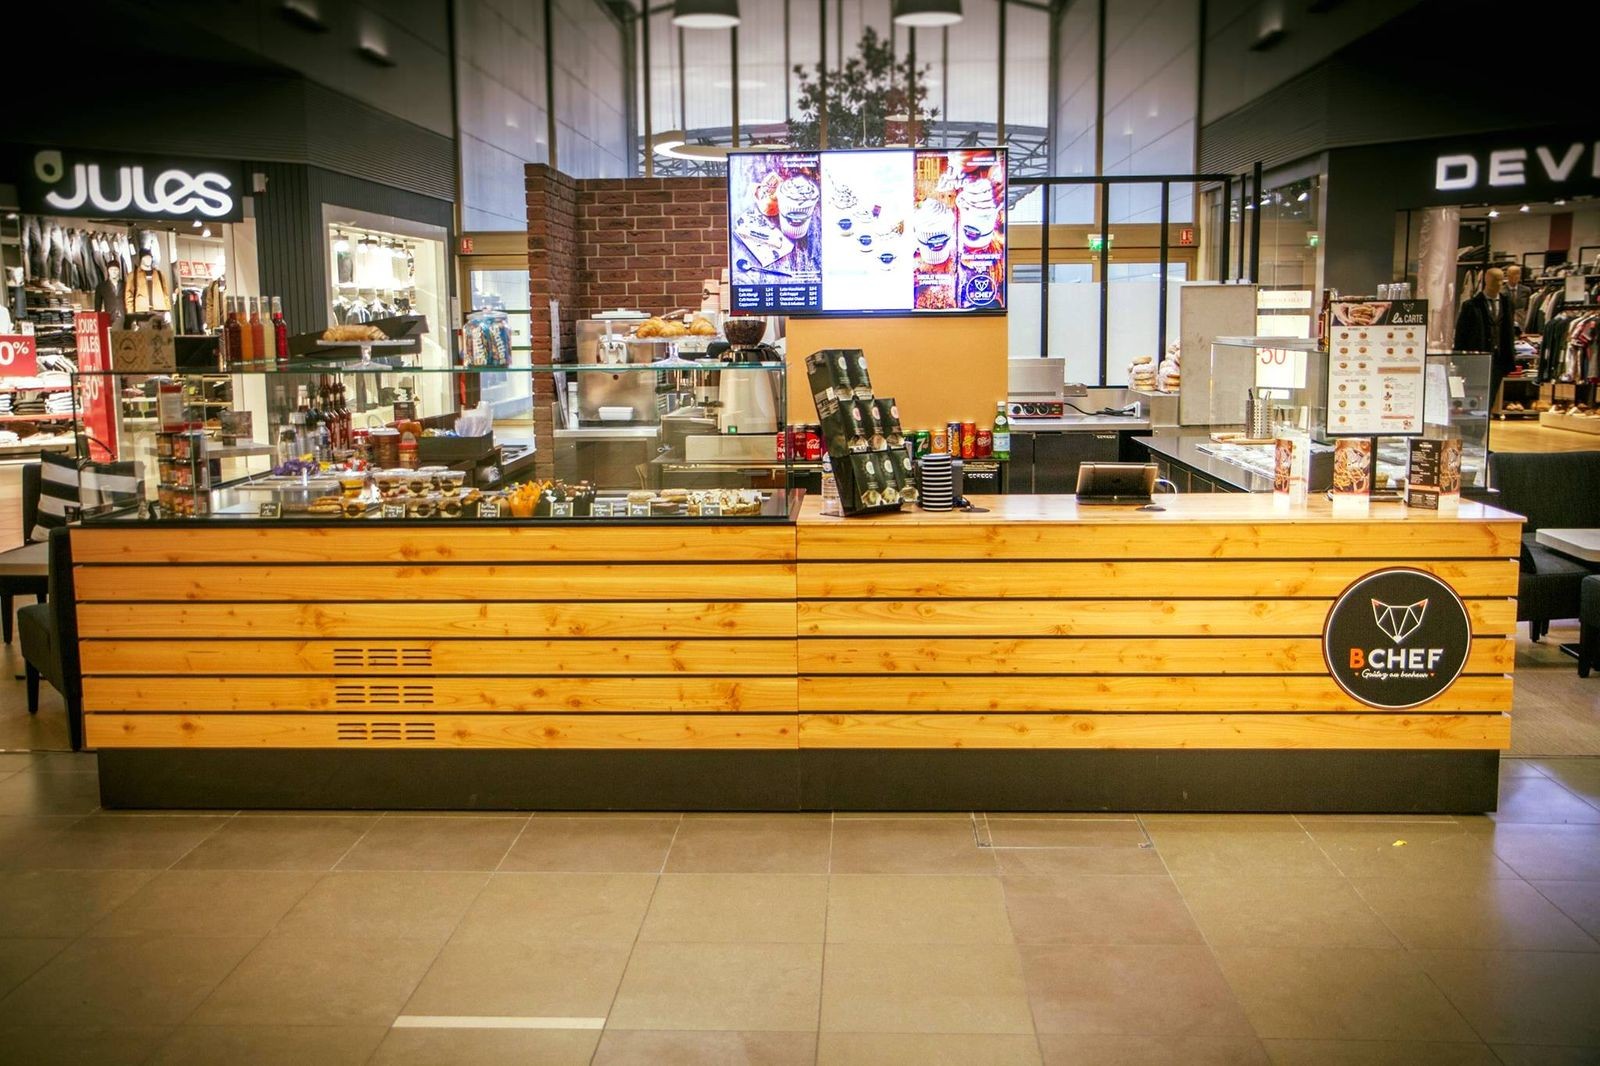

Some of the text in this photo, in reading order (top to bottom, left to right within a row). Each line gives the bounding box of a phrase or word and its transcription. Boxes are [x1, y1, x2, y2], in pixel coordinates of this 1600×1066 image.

[1435, 141, 1600, 191] DEV
[77, 318, 98, 334] JOURS
[1392, 312, 1423, 324] la CARTE
[79, 335, 100, 353] JULES
[1349, 648, 1443, 669] BCHEF
